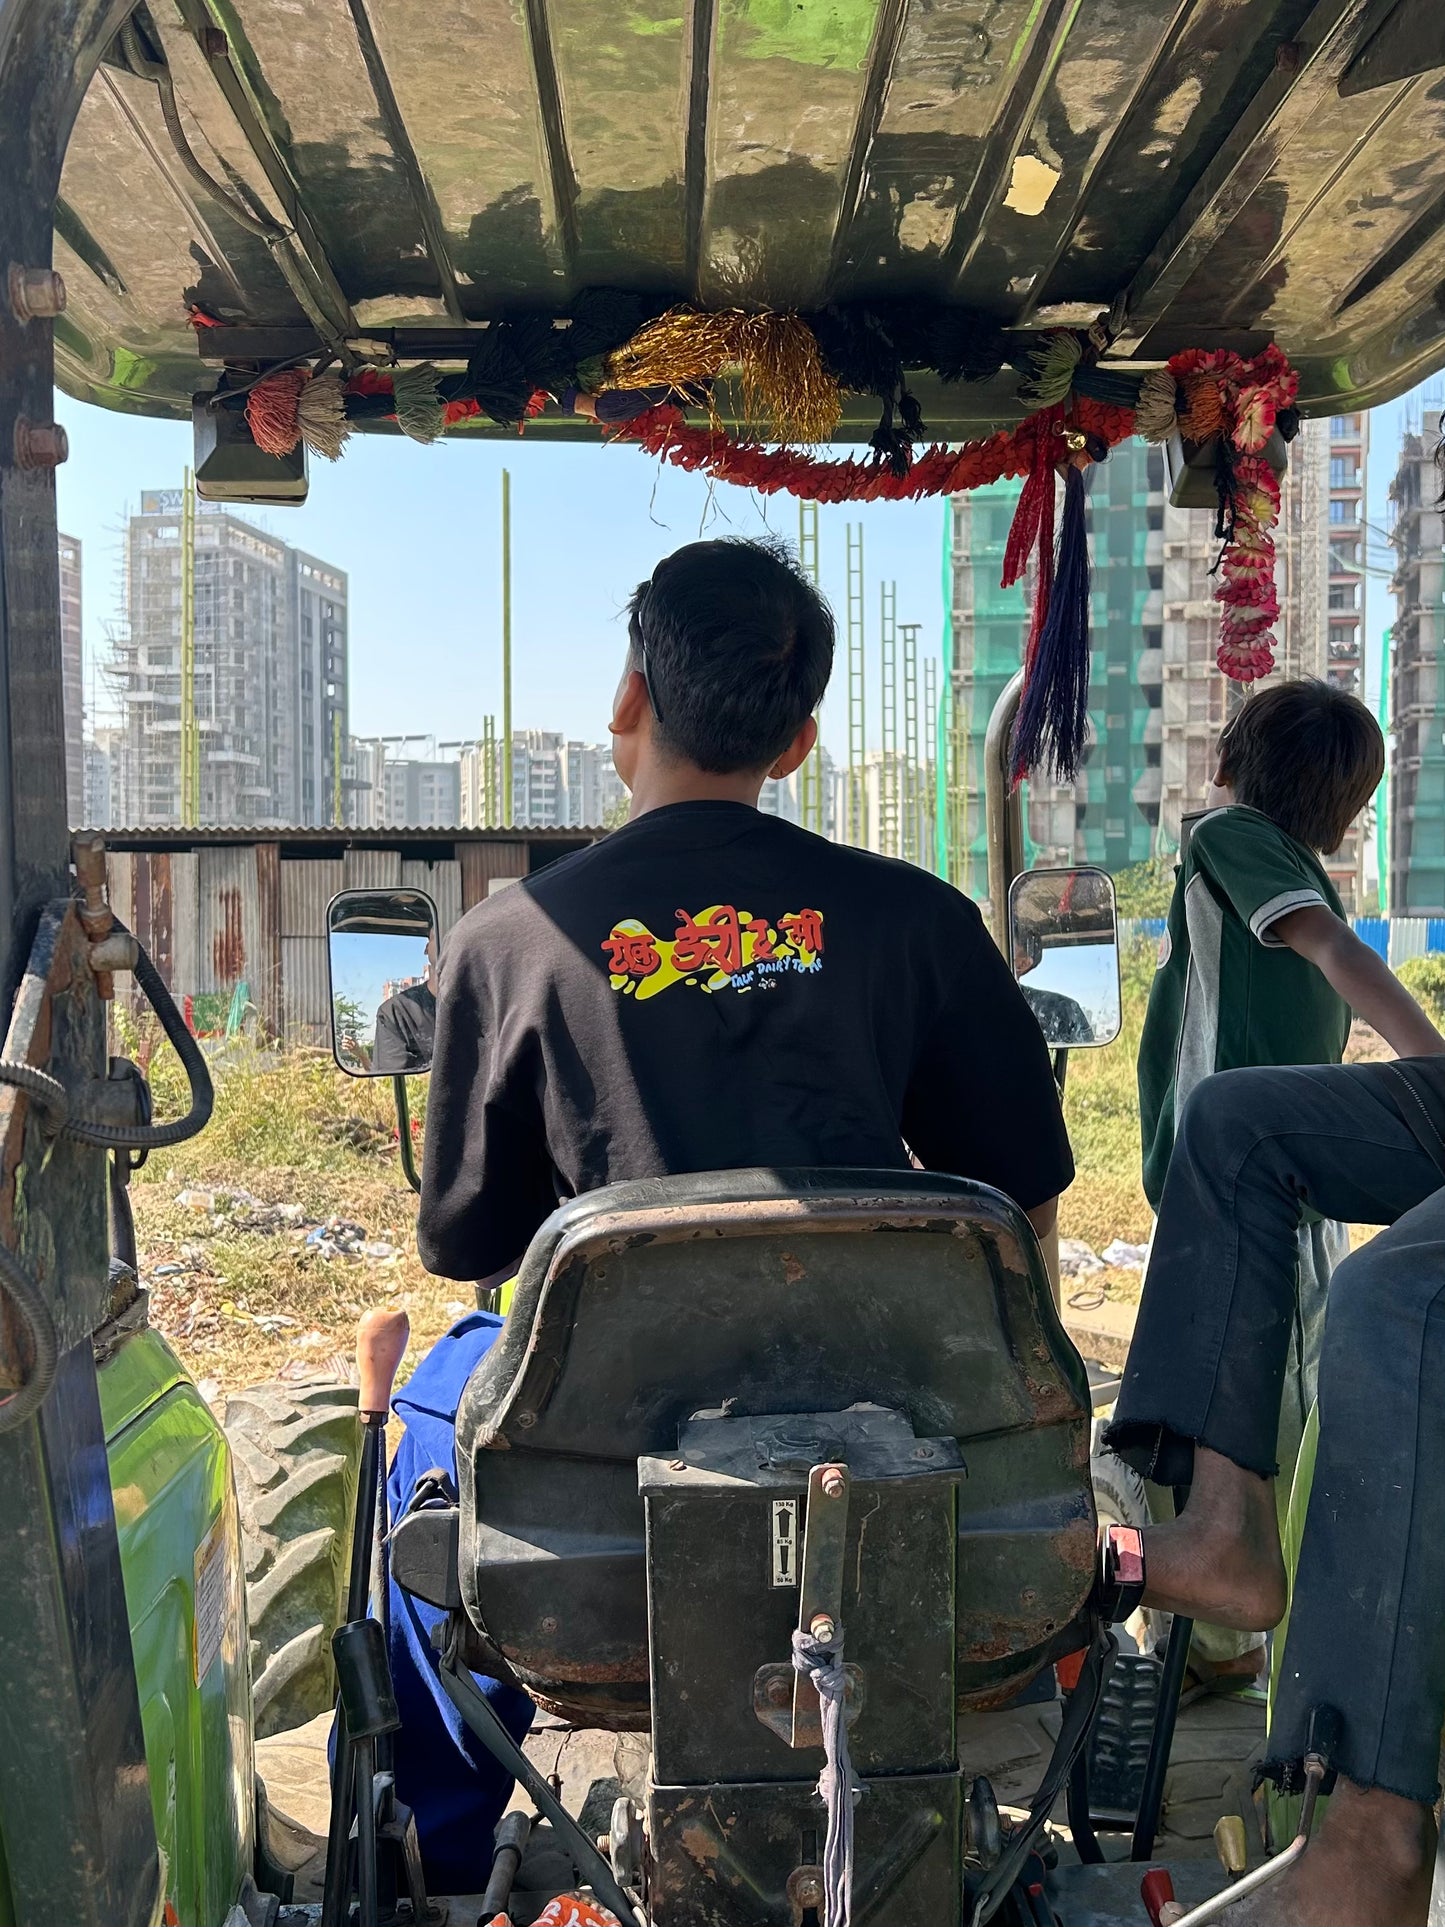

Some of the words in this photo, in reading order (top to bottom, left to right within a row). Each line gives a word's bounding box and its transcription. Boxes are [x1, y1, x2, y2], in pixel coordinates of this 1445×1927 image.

[671, 905, 742, 973] डेरी
[777, 908, 823, 952] मी
[731, 970, 755, 988] TALK
[756, 956, 791, 974] DAIRY
[792, 958, 806, 974] TO
